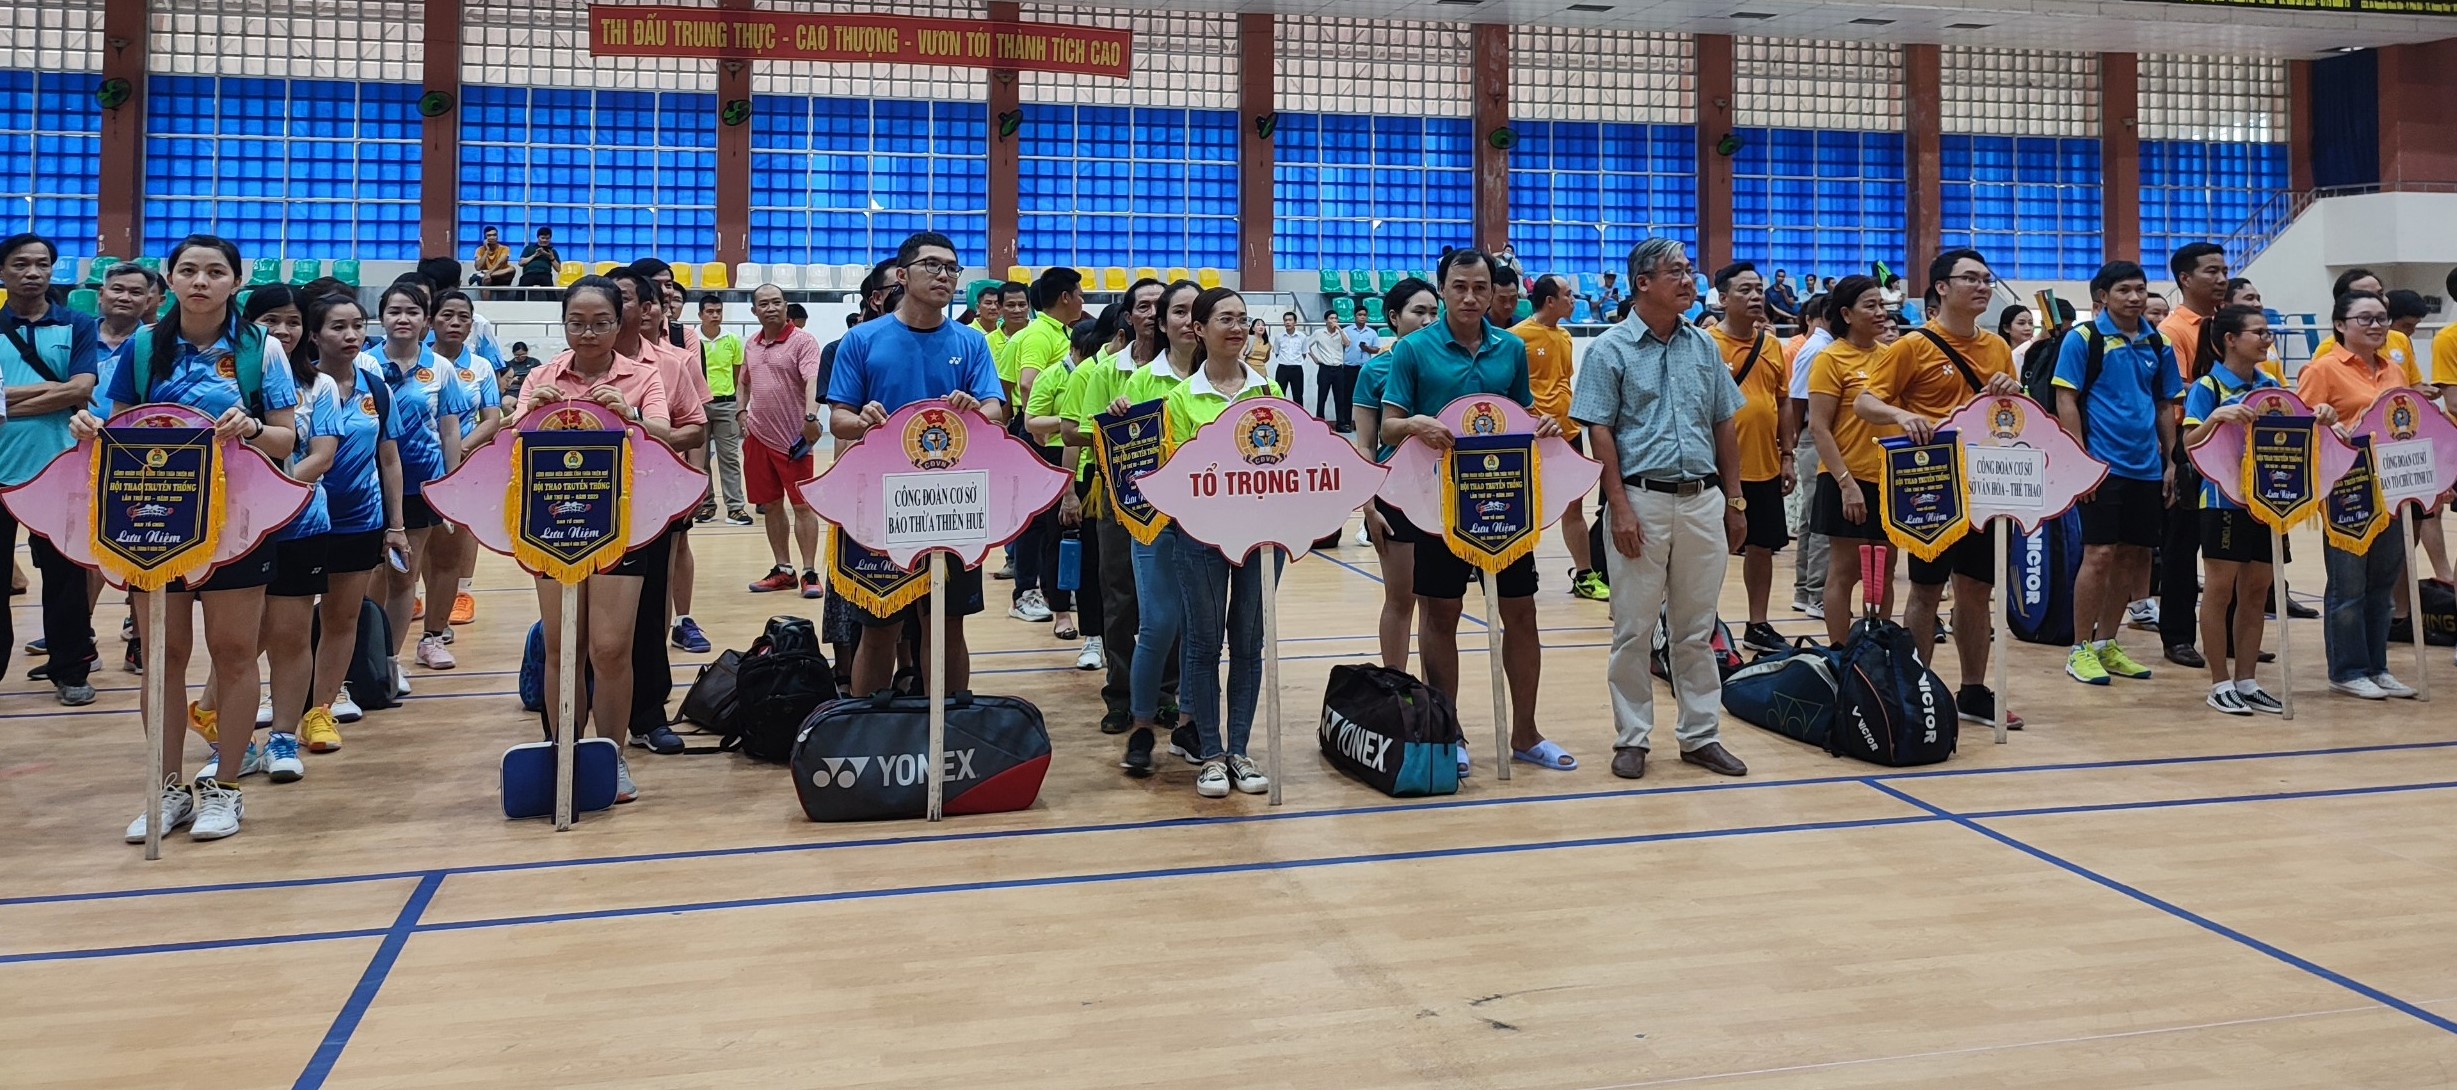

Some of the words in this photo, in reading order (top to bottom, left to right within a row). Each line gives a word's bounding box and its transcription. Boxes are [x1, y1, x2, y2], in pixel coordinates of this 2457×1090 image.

[601, 18, 627, 45] THI
[633, 12, 667, 46] ĐẤU
[673, 20, 727, 48] TRUNG
[733, 22, 776, 54] THỰC
[796, 24, 828, 50] CAO
[834, 25, 898, 57] THƯỢNG
[918, 28, 961, 56] VƯƠN
[966, 26, 990, 57] TỚI
[996, 29, 1046, 61] THÀNH
[1052, 32, 1085, 64] TÍCH
[1090, 40, 1121, 66] CAO
[1977, 456, 1994, 474] CÔNG
[1995, 457, 2013, 475] ĐOÀN
[2014, 461, 2023, 476] CƠ
[2024, 458, 2033, 476] SỞ
[2383, 452, 2397, 470] CÔNG
[1189, 463, 1218, 497] TỔ
[1225, 470, 1299, 499] TRỌNG
[1306, 463, 1340, 492] TÀI
[1977, 478, 1991, 495] VĂN
[1992, 478, 2005, 496] HÓA
[2010, 478, 2023, 497] THỂ
[2024, 483, 2041, 498] THAO
[895, 484, 921, 507] CÔNG
[923, 483, 948, 505] ĐOÀN
[950, 486, 963, 504] CƠ
[965, 482, 977, 504] SỞ
[540, 527, 564, 539] Lưu
[568, 526, 600, 540] Niệm
[888, 512, 907, 534] BÁO
[909, 510, 935, 532] THỪA
[936, 509, 964, 531] THIÊN
[966, 507, 984, 530] HUẾ
[1469, 523, 1489, 534] Lưu
[1492, 522, 1516, 534] Niệm
[116, 530, 140, 542] Lưu
[146, 530, 181, 545] Niệm
[855, 558, 878, 570] Lưu
[2026, 526, 2042, 604] VICTOR
[1918, 671, 1937, 744] VICTOR
[1337, 720, 1393, 772] YONEX
[1858, 718, 1878, 752] VICTOR
